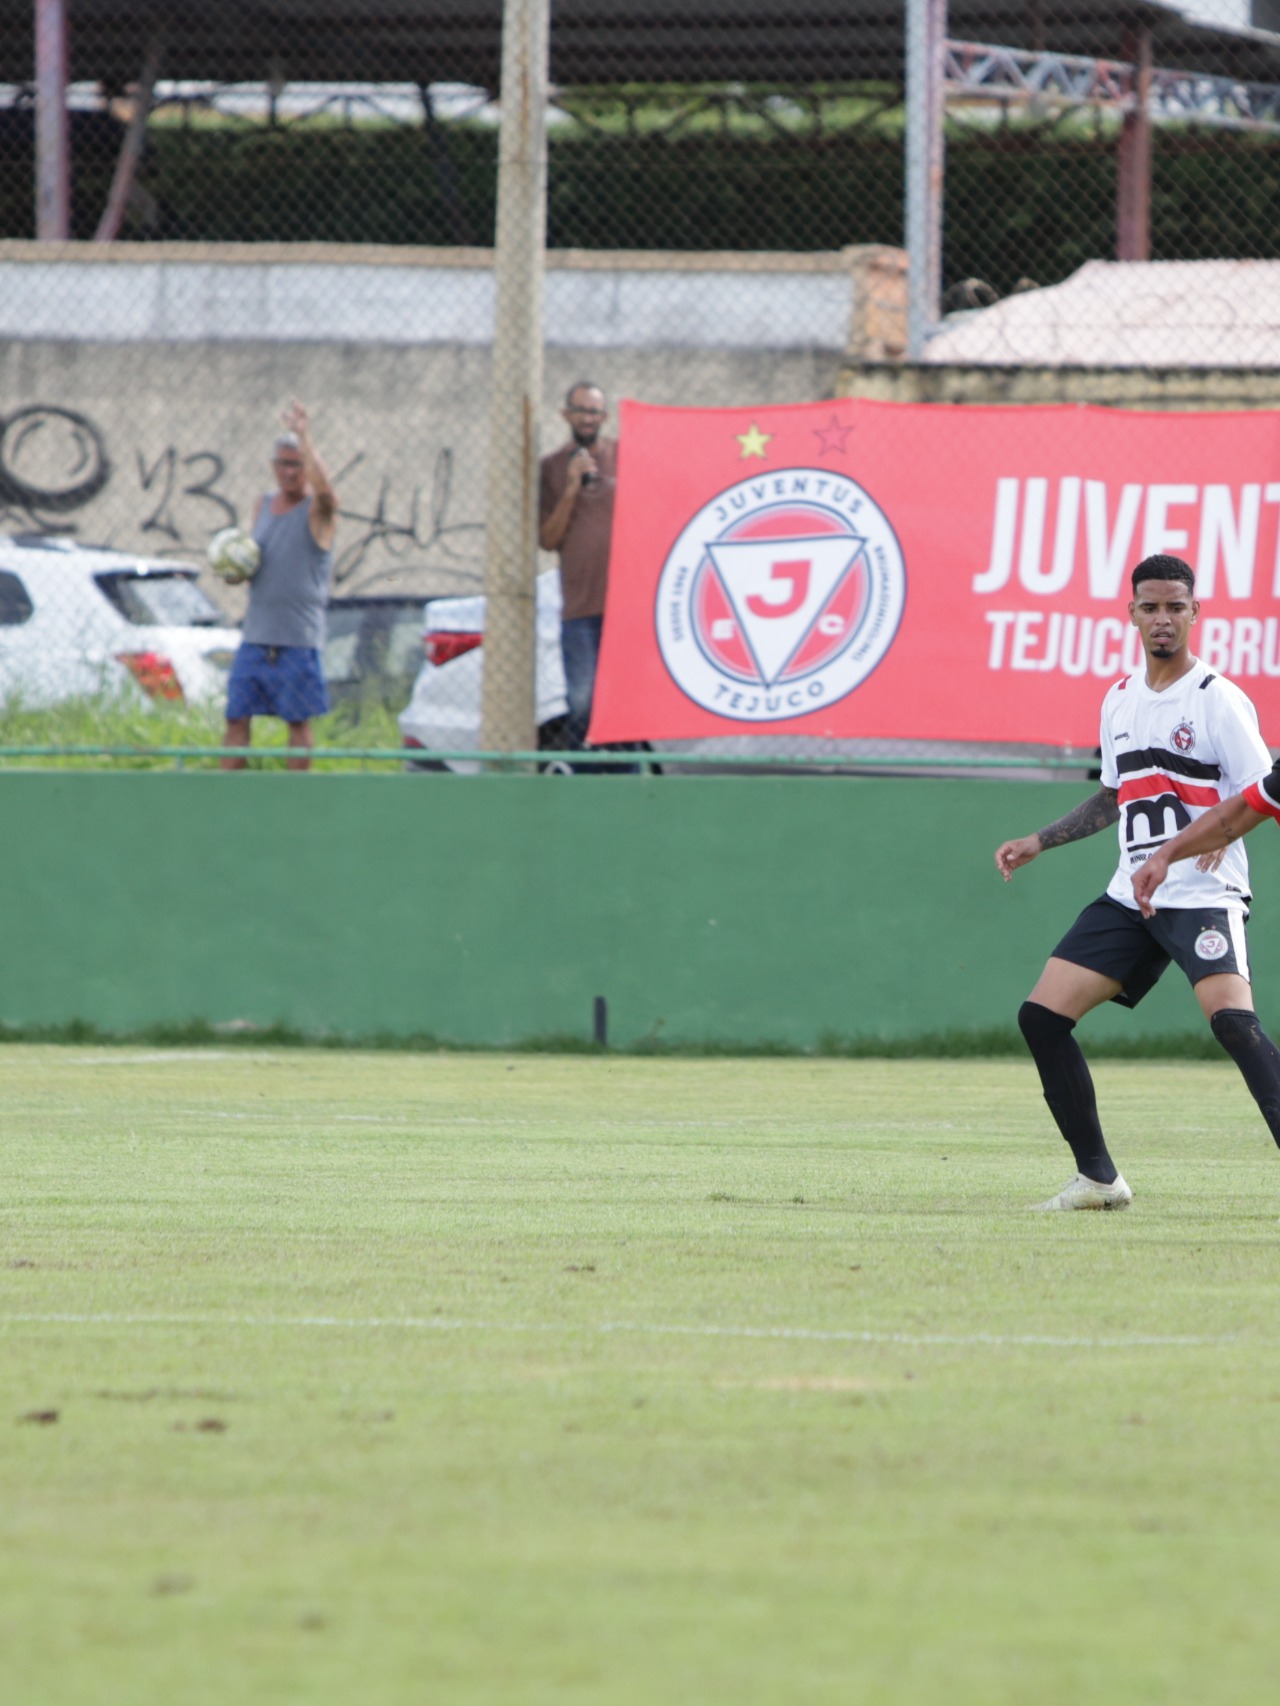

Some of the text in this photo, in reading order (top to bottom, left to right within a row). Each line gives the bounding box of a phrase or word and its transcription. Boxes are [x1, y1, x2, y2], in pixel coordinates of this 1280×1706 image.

[714, 477, 863, 522] JUVENTUS
[745, 559, 812, 620] J
[984, 611, 1148, 679] TEJUCO
[713, 681, 825, 713] TEJUCO
